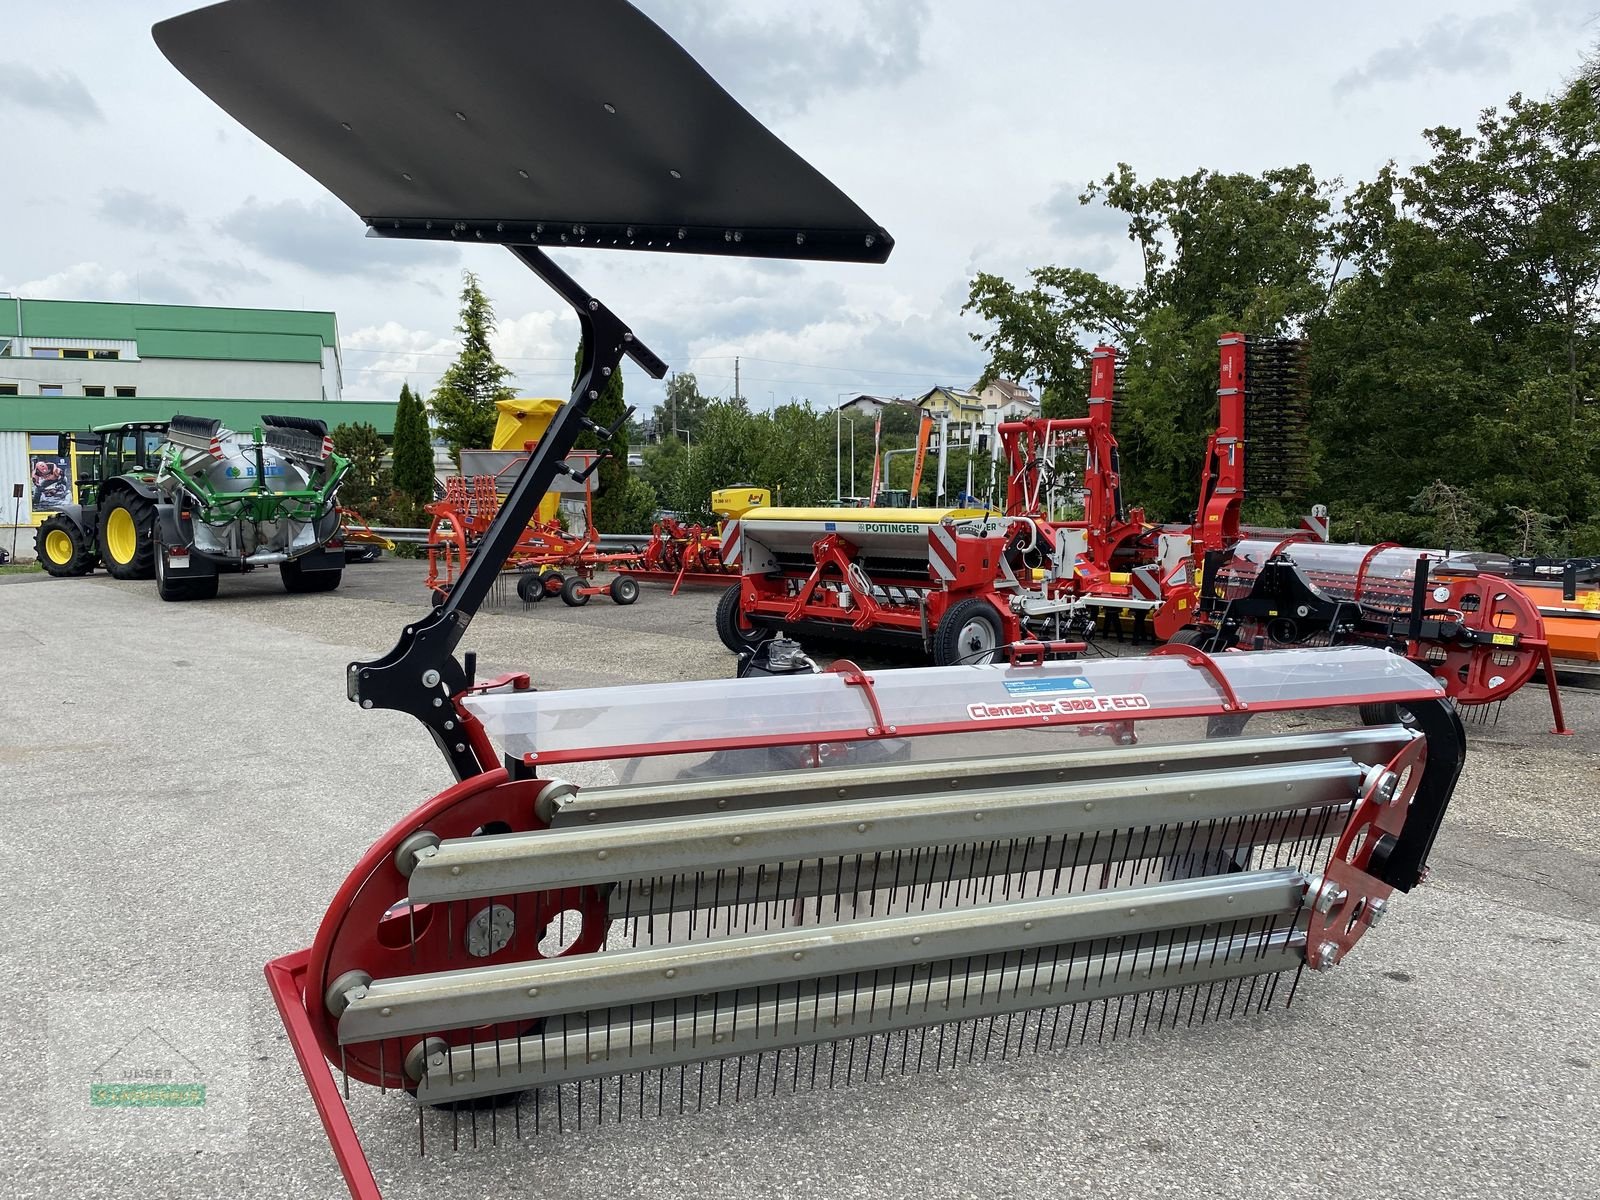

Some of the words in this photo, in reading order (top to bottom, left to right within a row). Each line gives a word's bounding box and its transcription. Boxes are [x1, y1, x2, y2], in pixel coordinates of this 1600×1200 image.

[971, 702, 1055, 717] Clementer
[1061, 699, 1096, 711] 300
[1113, 696, 1148, 708] ECO
